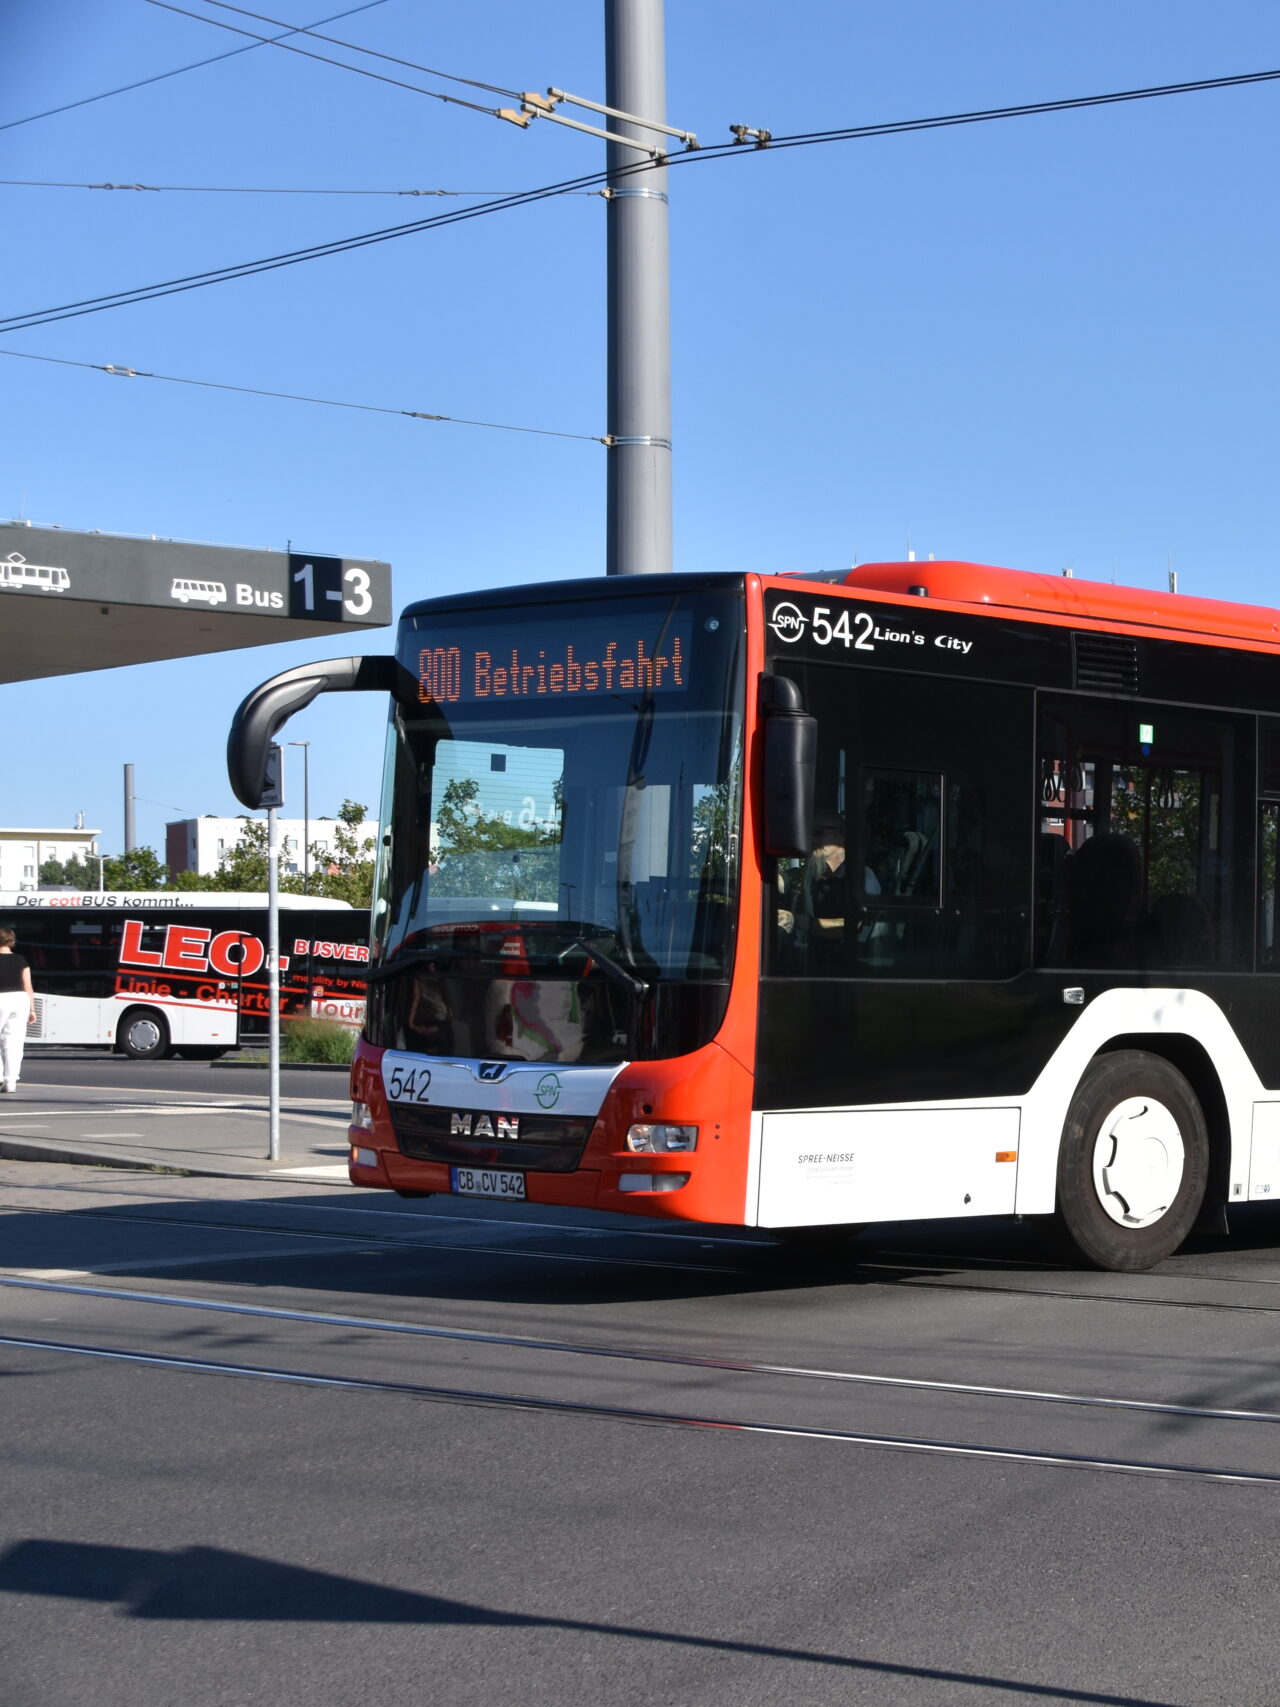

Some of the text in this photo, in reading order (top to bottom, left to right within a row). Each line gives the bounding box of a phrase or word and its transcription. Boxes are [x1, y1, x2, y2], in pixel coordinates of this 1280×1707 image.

[236, 564, 373, 616] Bus 1-3
[812, 607, 875, 651] 542
[873, 626, 926, 646] Lion's
[934, 634, 974, 654] City
[474, 637, 684, 698] Betriebsfahrt
[16, 895, 44, 908] Der
[49, 895, 117, 908] cottBUS
[114, 975, 172, 998] Linie
[389, 1066, 432, 1103] 542
[450, 1112, 520, 1140] MAN
[797, 1152, 855, 1165] SPREE-NEISSE
[458, 1171, 524, 1195] CB CV 542
